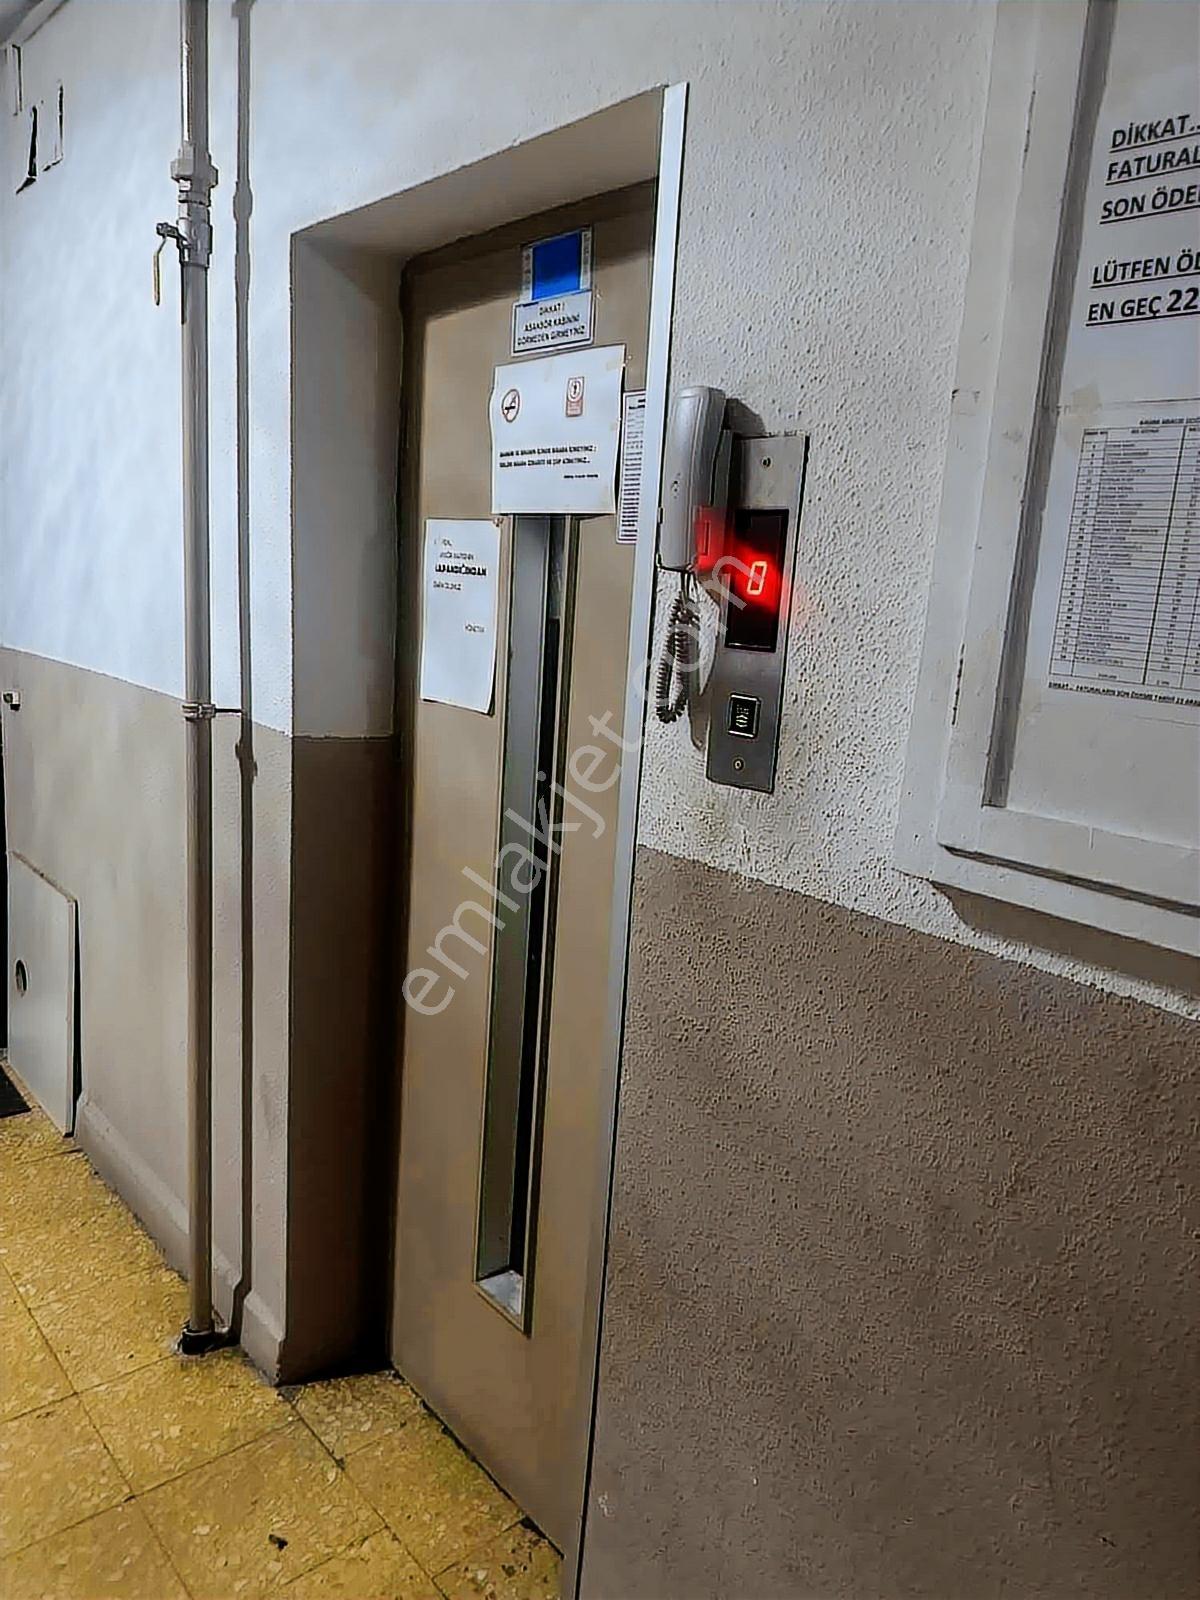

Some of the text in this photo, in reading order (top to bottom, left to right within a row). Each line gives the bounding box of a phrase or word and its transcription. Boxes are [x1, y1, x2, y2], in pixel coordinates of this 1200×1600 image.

[1101, 186, 1200, 219] SON ÖDE
[1093, 256, 1171, 285] LÜTFEN
[1088, 287, 1199, 321] EN GEÇ 22
